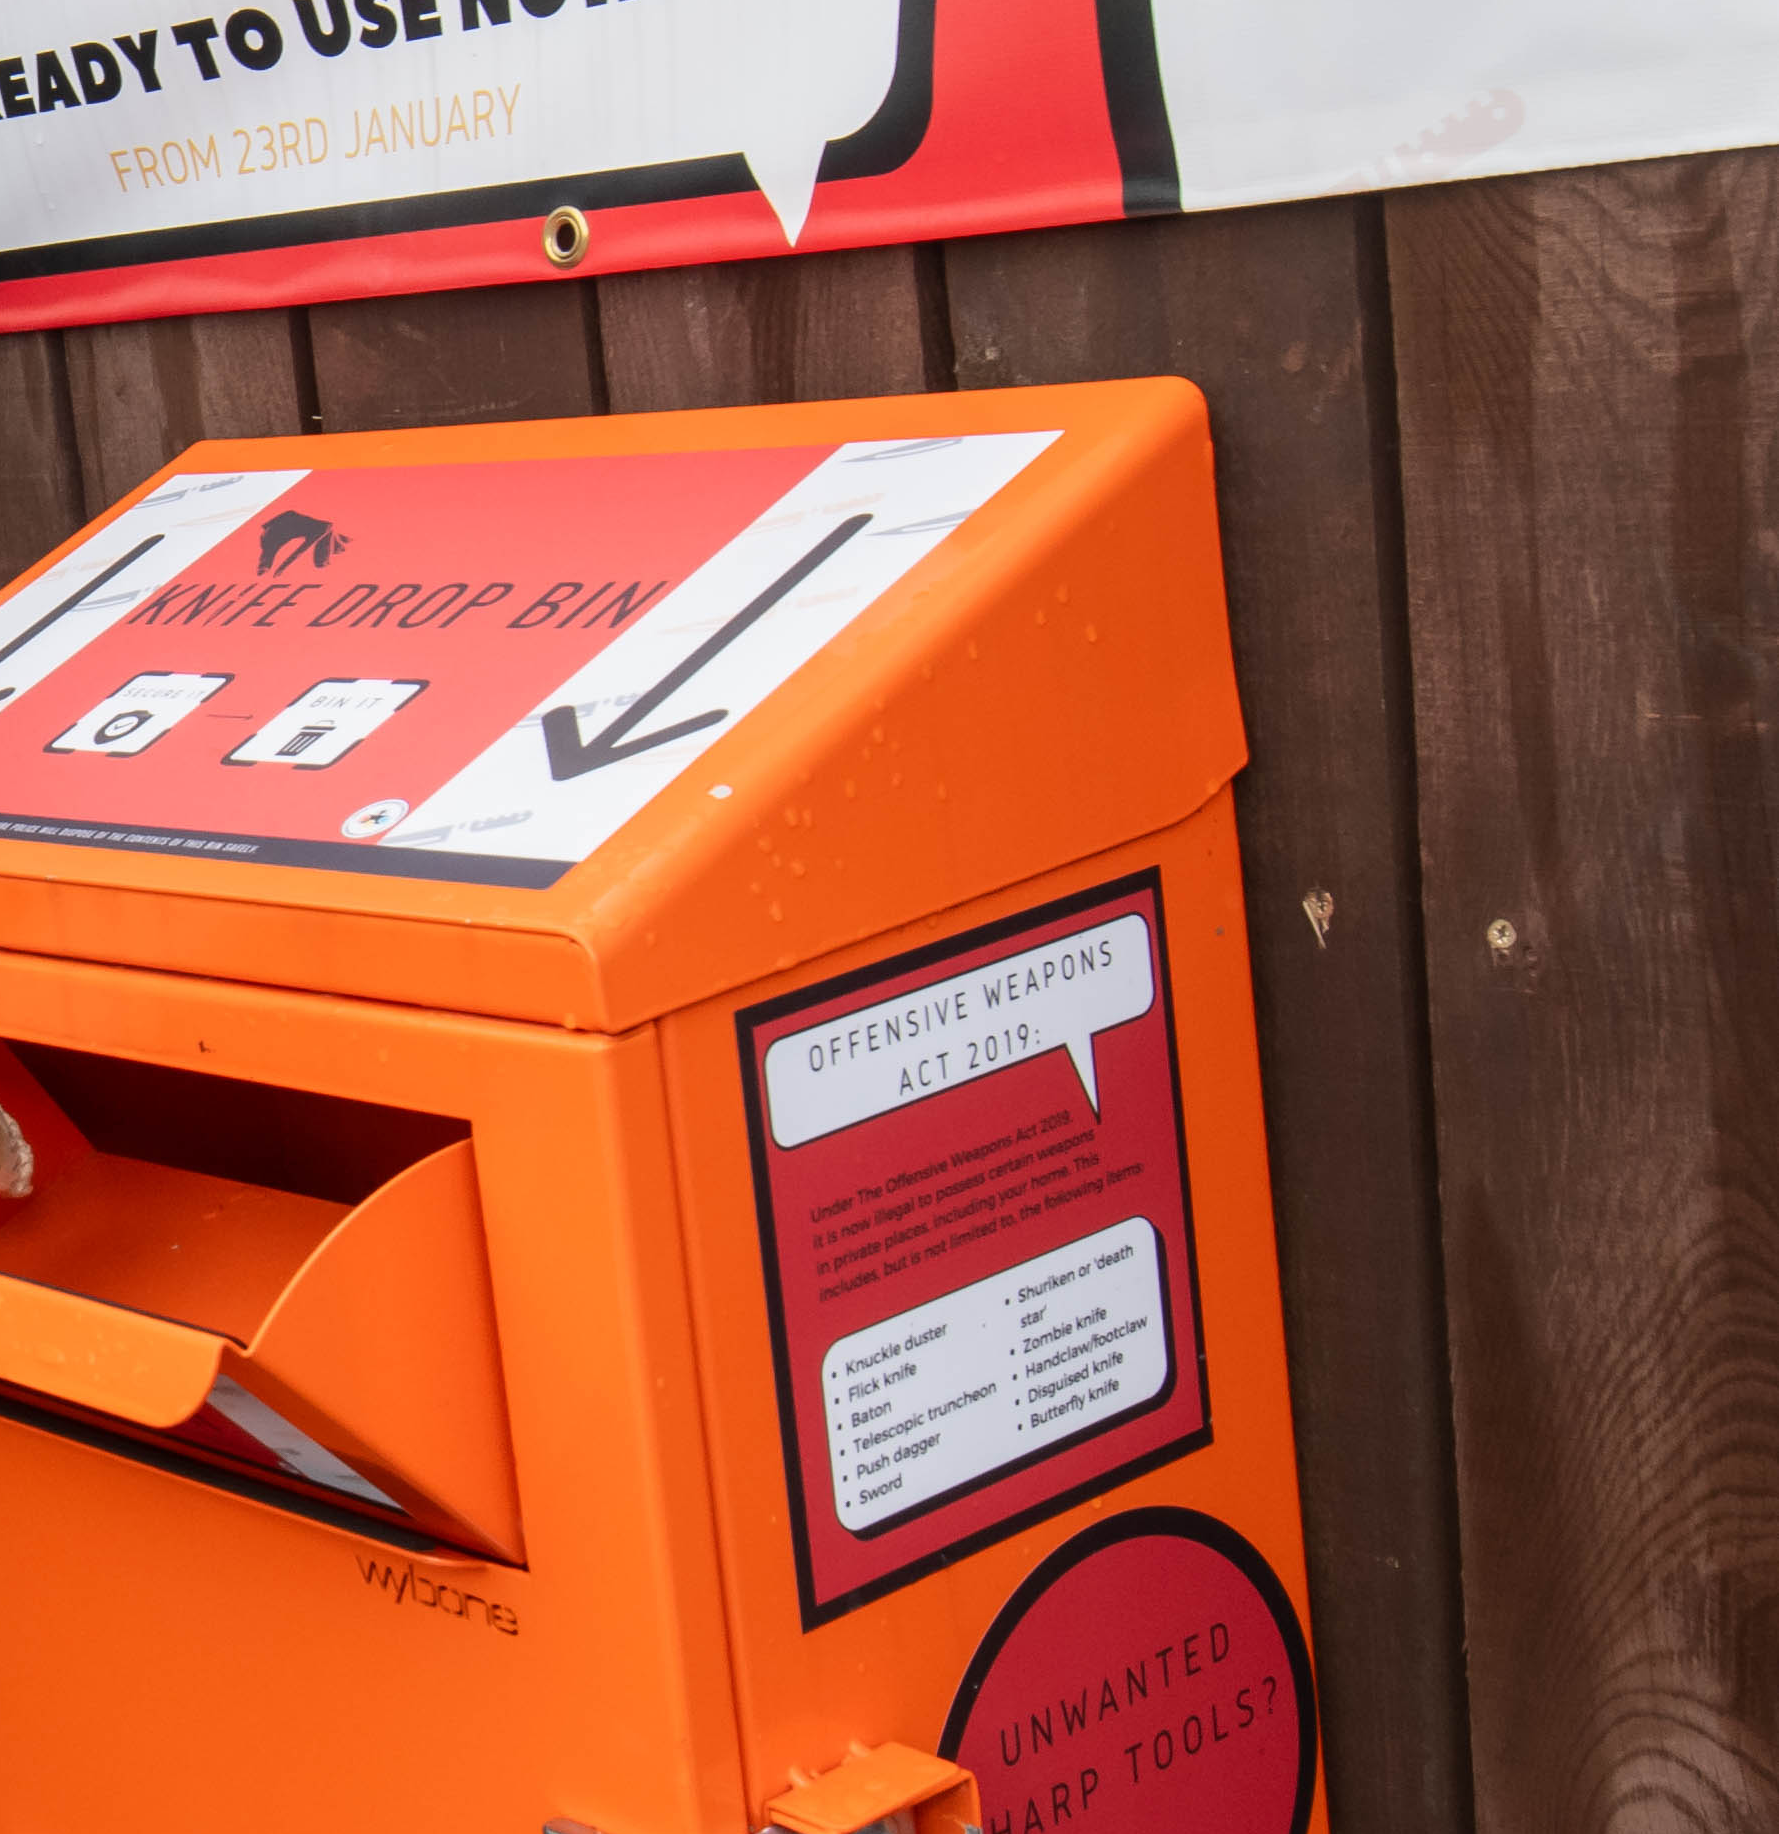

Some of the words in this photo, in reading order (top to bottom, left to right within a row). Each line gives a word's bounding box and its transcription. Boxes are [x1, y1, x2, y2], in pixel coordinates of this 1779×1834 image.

[175, 7, 284, 81] TO
[109, 131, 222, 194] FROM
[232, 116, 329, 176] 23RD
[344, 84, 522, 159] JANUARY
[306, 582, 515, 629] DROP
[506, 580, 670, 629] BIN
[309, 694, 349, 709] BIN
[359, 695, 386, 710] IT
[809, 992, 967, 1072] OFFENSIVE
[983, 940, 1113, 1008] WEAPONS
[899, 1052, 949, 1096] ACT
[967, 1023, 1041, 1070] 2019:
[810, 1196, 854, 1224] Under
[857, 1184, 882, 1205] The
[885, 1160, 948, 1194] Offensive
[951, 1134, 1012, 1169] Weapons
[1015, 1124, 1038, 1144] Act
[813, 1234, 824, 1250] it
[827, 1230, 838, 1245] is
[840, 1218, 872, 1239] now
[874, 1200, 915, 1226] illegal
[917, 1193, 933, 1208] to
[936, 1174, 986, 1203] possess
[988, 1151, 1034, 1180] certain
[1037, 1128, 1096, 1164] weapons
[816, 1260, 830, 1276] in
[833, 1241, 882, 1271] private
[933, 1196, 996, 1229] including
[997, 1184, 1029, 1206] your
[1072, 1151, 1100, 1173] This
[883, 1255, 907, 1278] but
[910, 1251, 922, 1266] is
[925, 1238, 948, 1260] not
[950, 1222, 997, 1250] limited
[1020, 1201, 1043, 1222] the
[1044, 1175, 1105, 1211] following
[1017, 1269, 1076, 1304] Shuriken
[1078, 1263, 1091, 1277] or
[1093, 1244, 1134, 1270] 'death
[845, 1342, 901, 1377] Knuckle
[904, 1322, 949, 1352] duster
[1020, 1305, 1047, 1329] star'
[1023, 1321, 1073, 1354] Zombie
[1075, 1306, 1107, 1331] knife
[1025, 1314, 1149, 1380] Handclaw/footclaw
[848, 1378, 881, 1403] Flick
[883, 1362, 917, 1387] knife
[1028, 1366, 1090, 1404] Disguised
[1092, 1350, 1124, 1375] knife
[1031, 1394, 1086, 1429] Butterfly
[1088, 1378, 1120, 1402] knife
[851, 1401, 892, 1428] Baton
[853, 1412, 925, 1454] Telescopic
[927, 1382, 997, 1422] truncheon
[856, 1454, 890, 1480] Push
[893, 1431, 941, 1464] dagger
[859, 1472, 903, 1505] Sword
[353, 1554, 518, 1636] wybone
[1000, 1622, 1230, 1767] UNWANTED
[1124, 1675, 1277, 1784] TOOLS?
